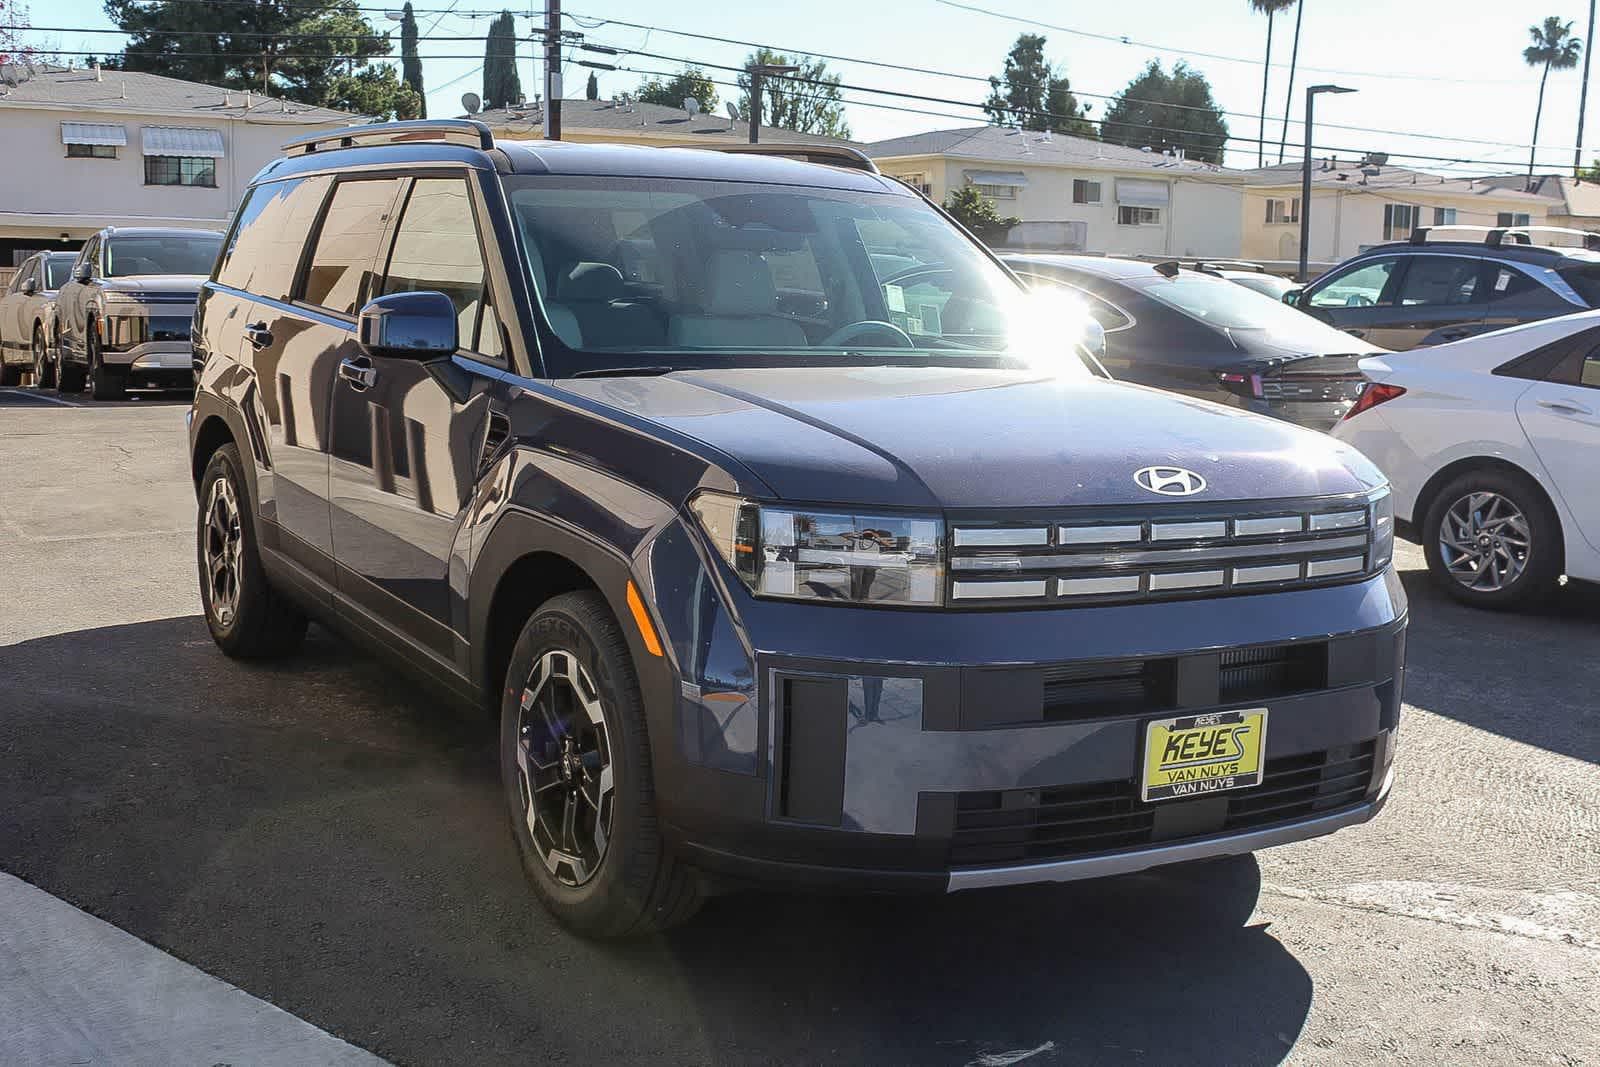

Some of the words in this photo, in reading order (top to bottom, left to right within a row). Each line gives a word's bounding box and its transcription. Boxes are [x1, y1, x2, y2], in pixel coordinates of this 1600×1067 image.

[1161, 726, 1251, 763] KEYES
[1168, 768, 1196, 782] VAN
[1200, 763, 1238, 778] NUYS
[1172, 781, 1196, 795] VAN
[1200, 778, 1235, 791] NUYS
